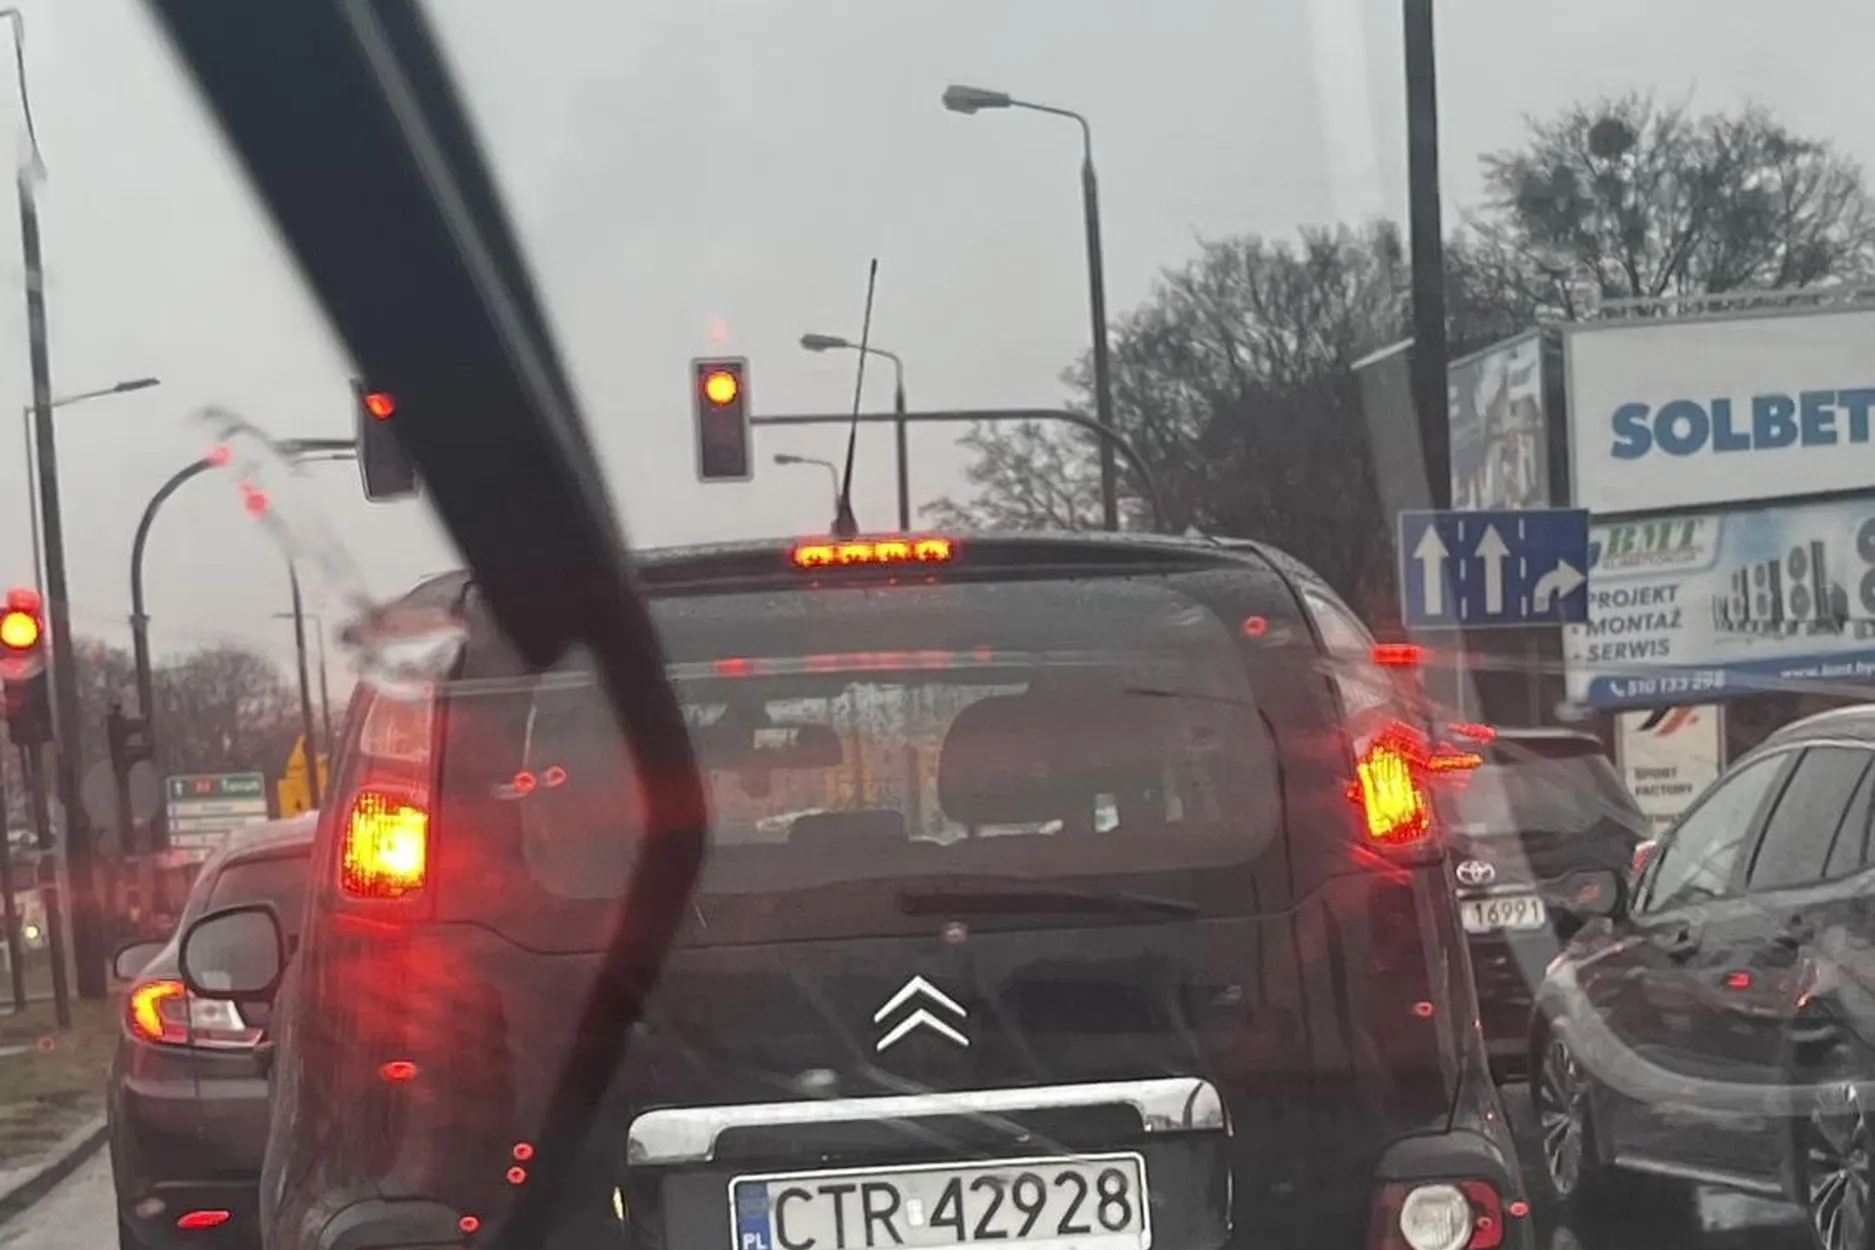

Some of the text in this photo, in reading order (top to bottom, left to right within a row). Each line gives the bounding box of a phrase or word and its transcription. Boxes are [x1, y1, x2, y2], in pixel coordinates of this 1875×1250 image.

[1610, 388, 1875, 460] SOLBET
[1586, 606, 1683, 637] MONTAŻ
[1586, 638, 1671, 662] SERWIS
[1475, 900, 1539, 926] 16991
[929, 1167, 1133, 1242] 42928
